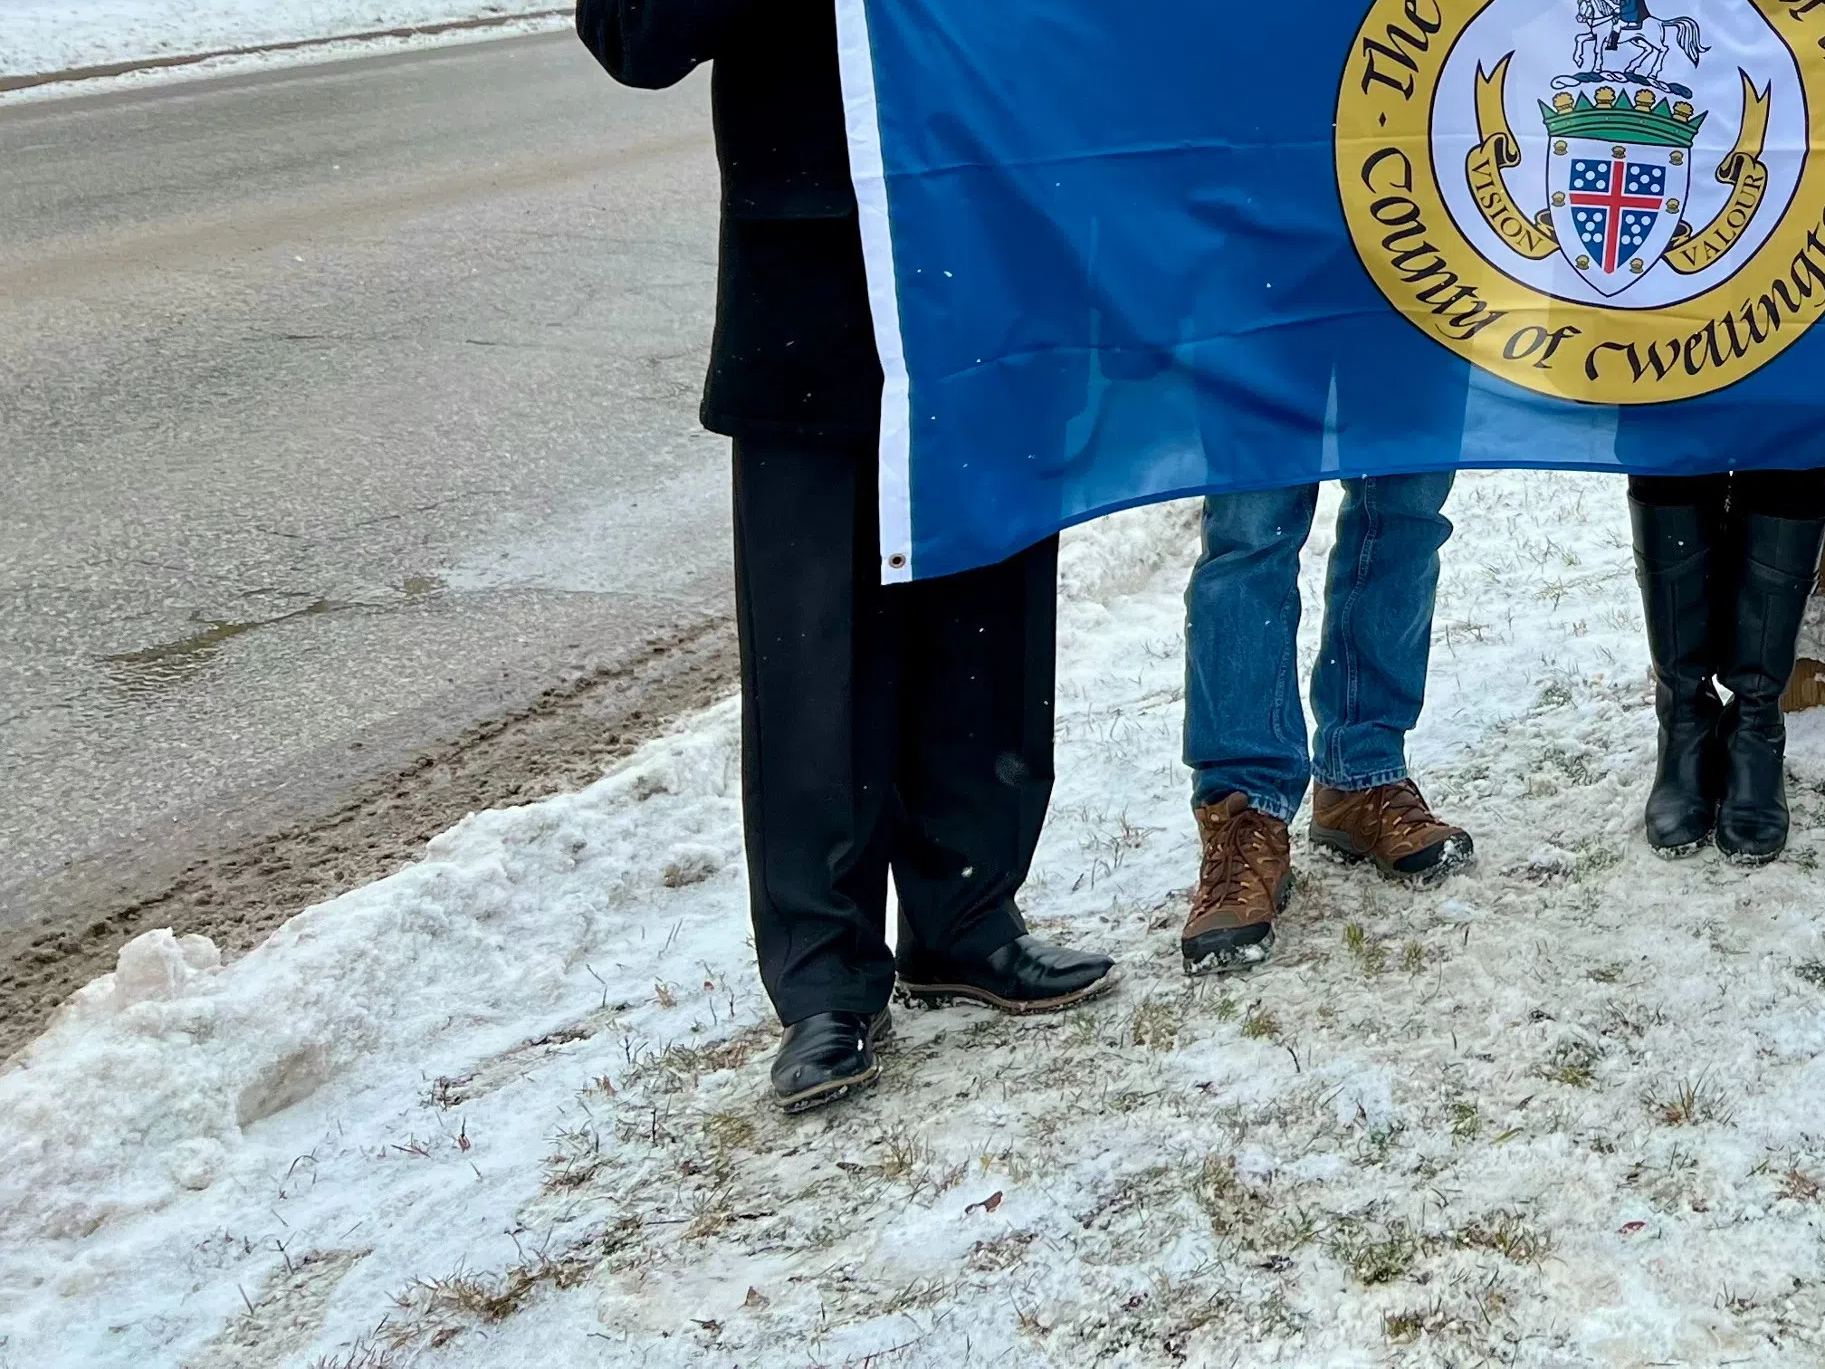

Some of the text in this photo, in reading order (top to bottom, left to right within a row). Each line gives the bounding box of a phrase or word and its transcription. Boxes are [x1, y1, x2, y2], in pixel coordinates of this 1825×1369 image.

[1472, 159, 1542, 252] VISION
[1680, 174, 1764, 267] VALOUR
[1361, 147, 1508, 340] County
[1503, 325, 1582, 369] of
